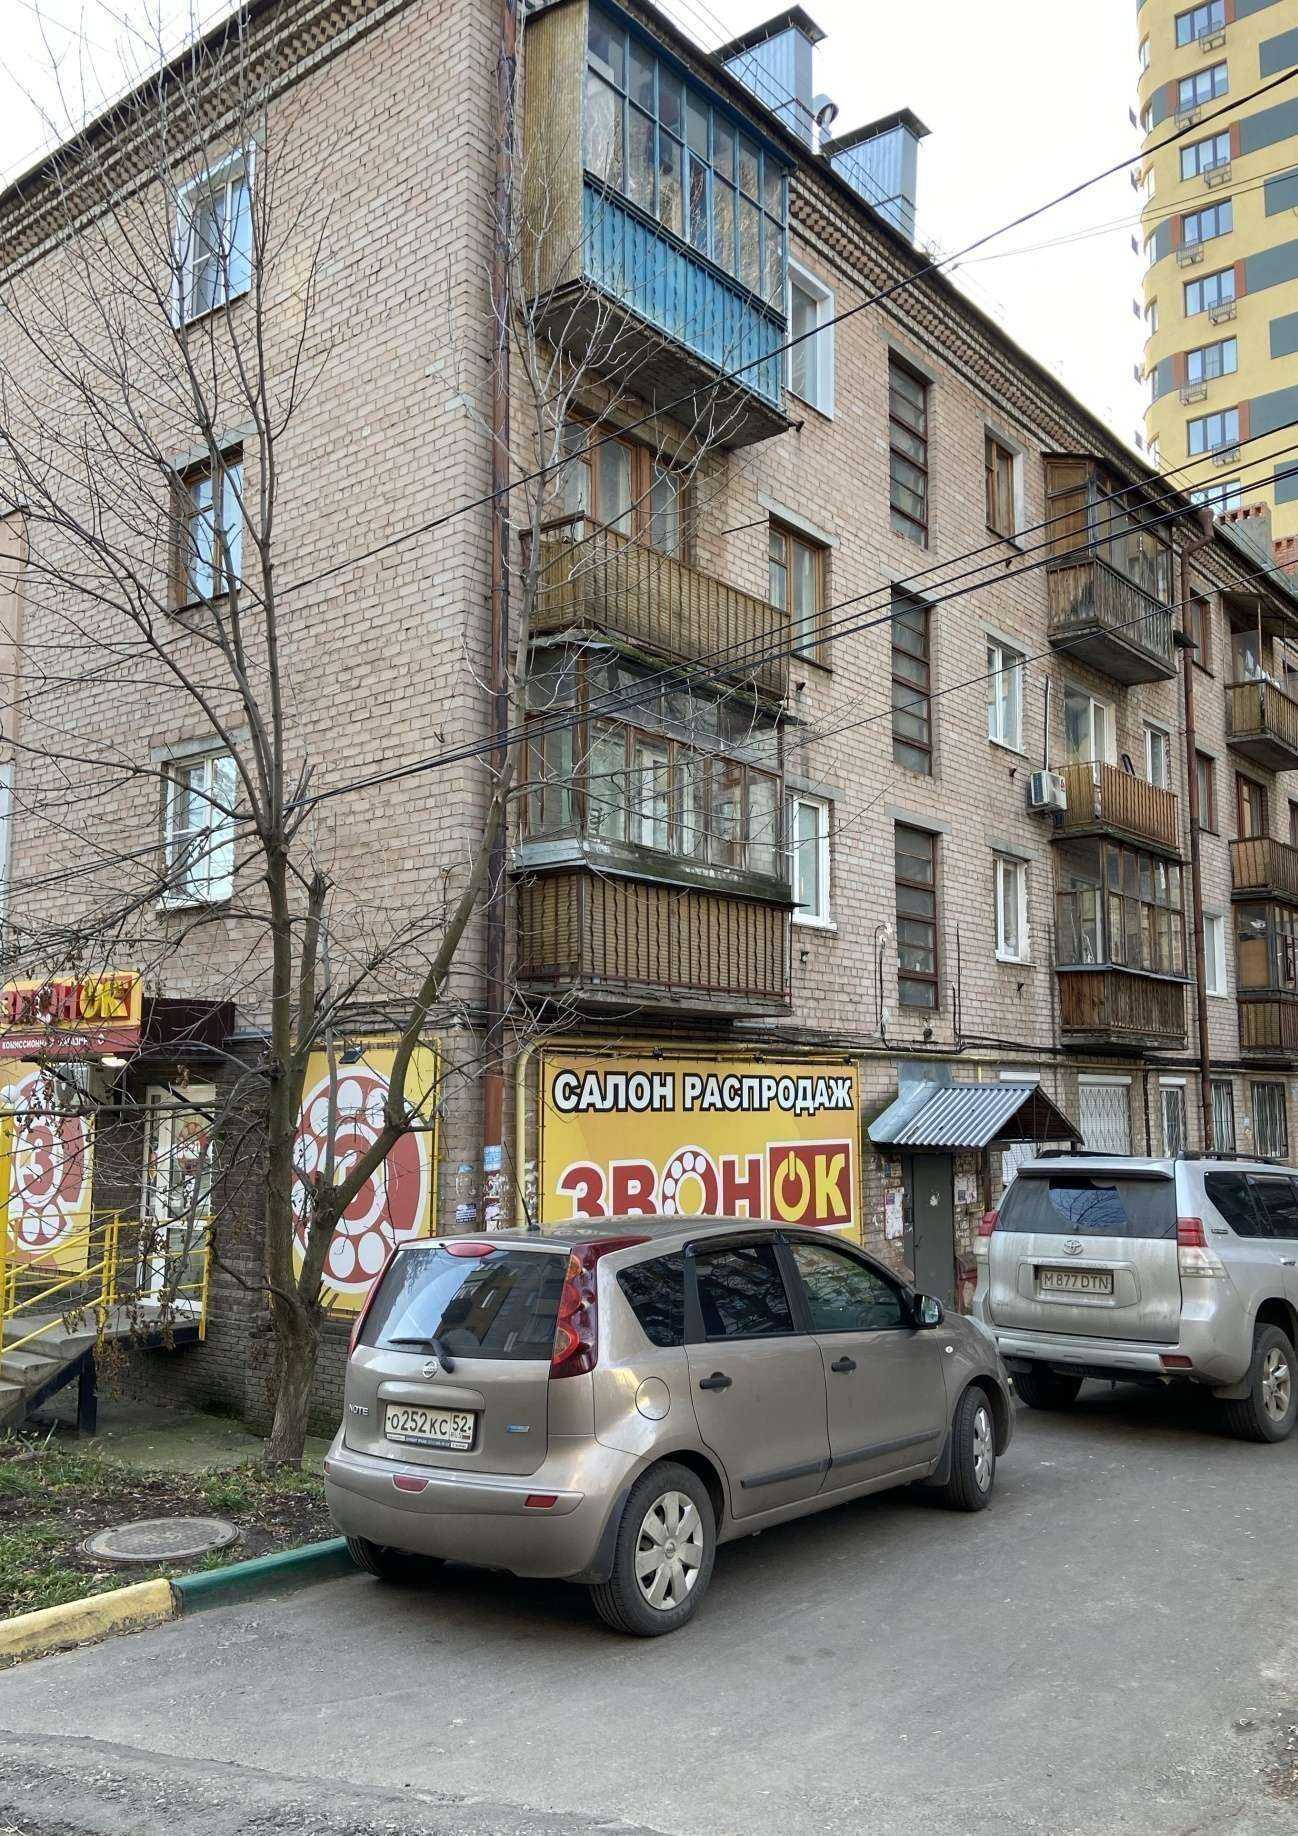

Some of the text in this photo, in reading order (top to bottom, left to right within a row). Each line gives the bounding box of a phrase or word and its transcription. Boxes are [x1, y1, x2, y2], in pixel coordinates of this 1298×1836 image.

[552, 1069, 854, 1117] САЛОН РАСПРОДАЖ
[557, 1142, 850, 1226] ЗВОНОК
